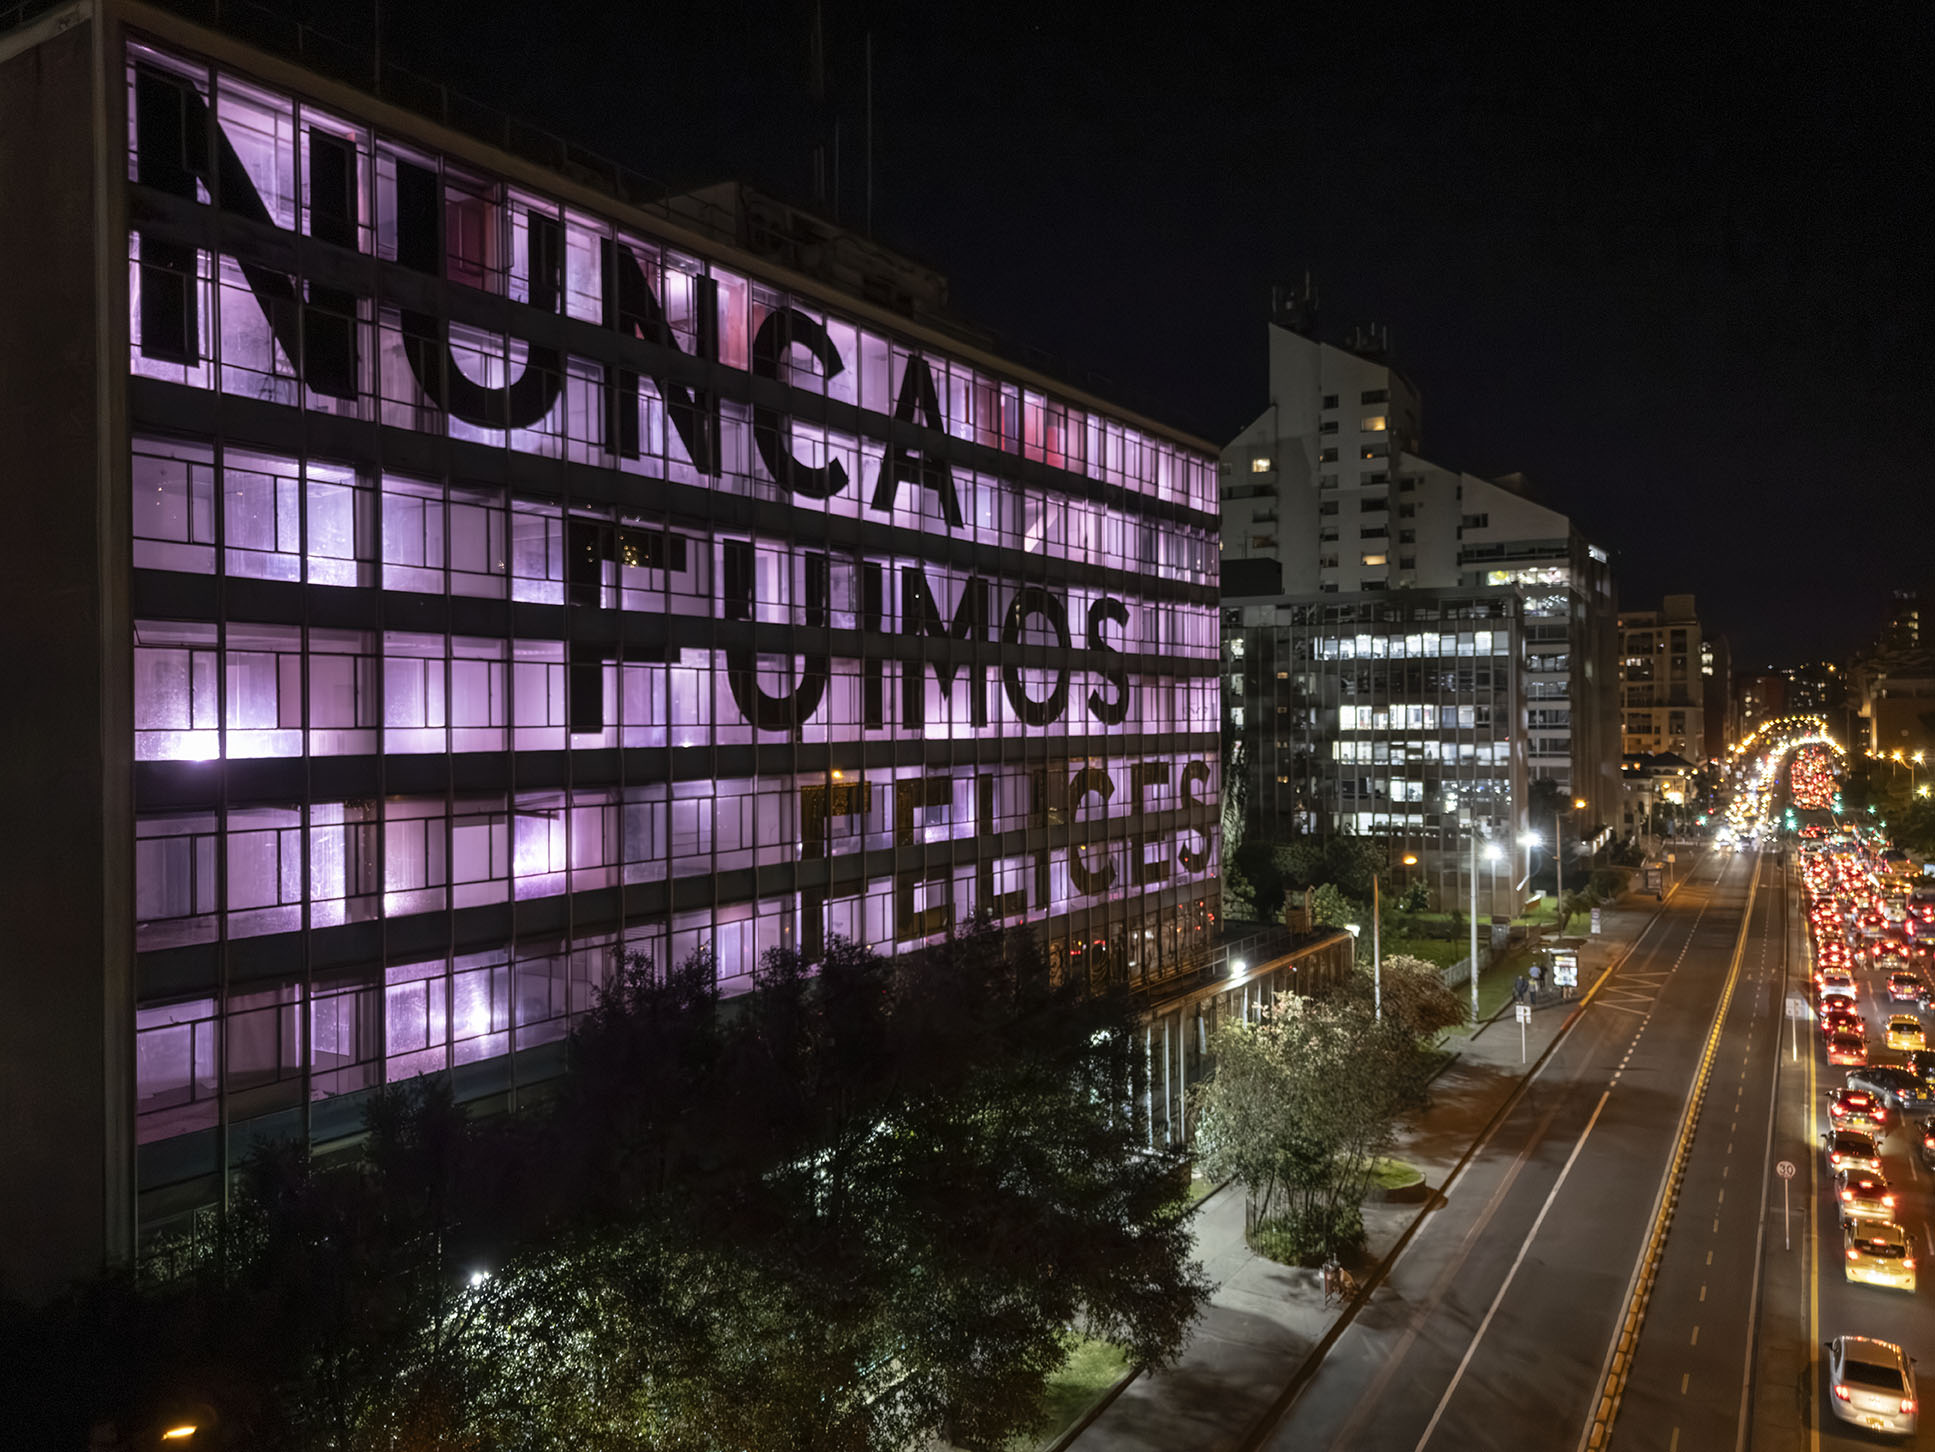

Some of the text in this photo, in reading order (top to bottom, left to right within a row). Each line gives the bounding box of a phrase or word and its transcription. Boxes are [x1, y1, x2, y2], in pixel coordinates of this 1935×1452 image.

[135, 61, 964, 528] NUNCA
[568, 517, 1130, 733] FUIMOS
[800, 760, 1212, 959] FELICES
[1779, 1164, 1793, 1175] 30
